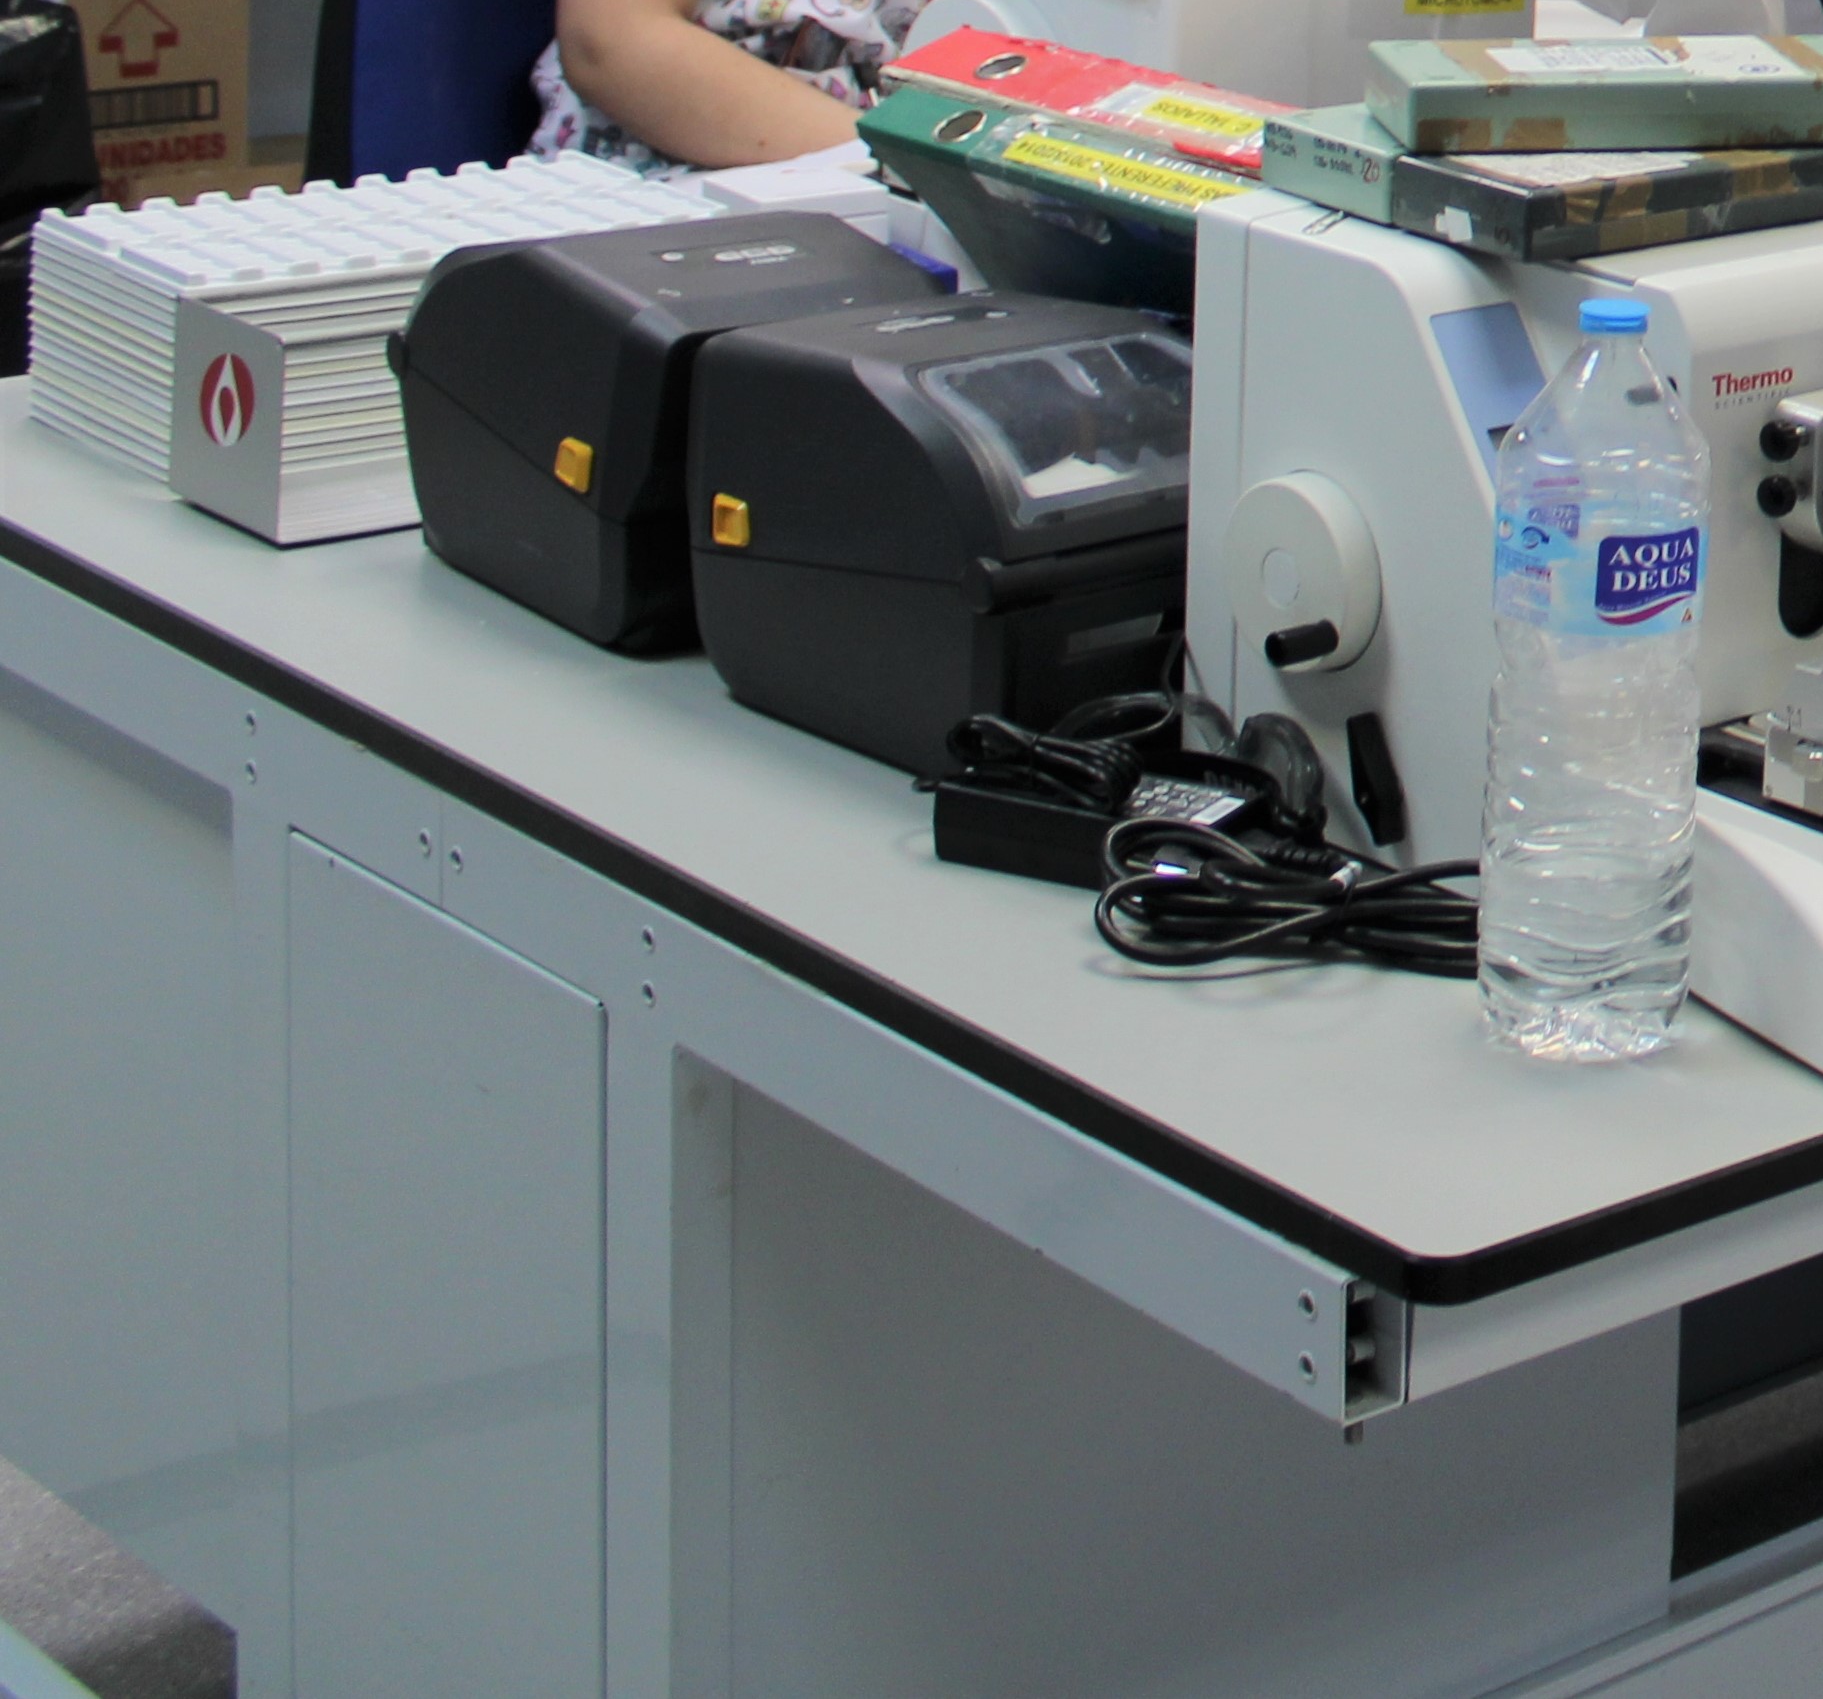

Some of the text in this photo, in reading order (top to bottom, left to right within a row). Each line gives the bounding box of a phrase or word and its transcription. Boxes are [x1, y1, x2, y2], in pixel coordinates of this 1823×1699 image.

[1712, 367, 1793, 397] Thermo
[1607, 536, 1694, 569] AQUA
[1611, 561, 1691, 592] DEUS
